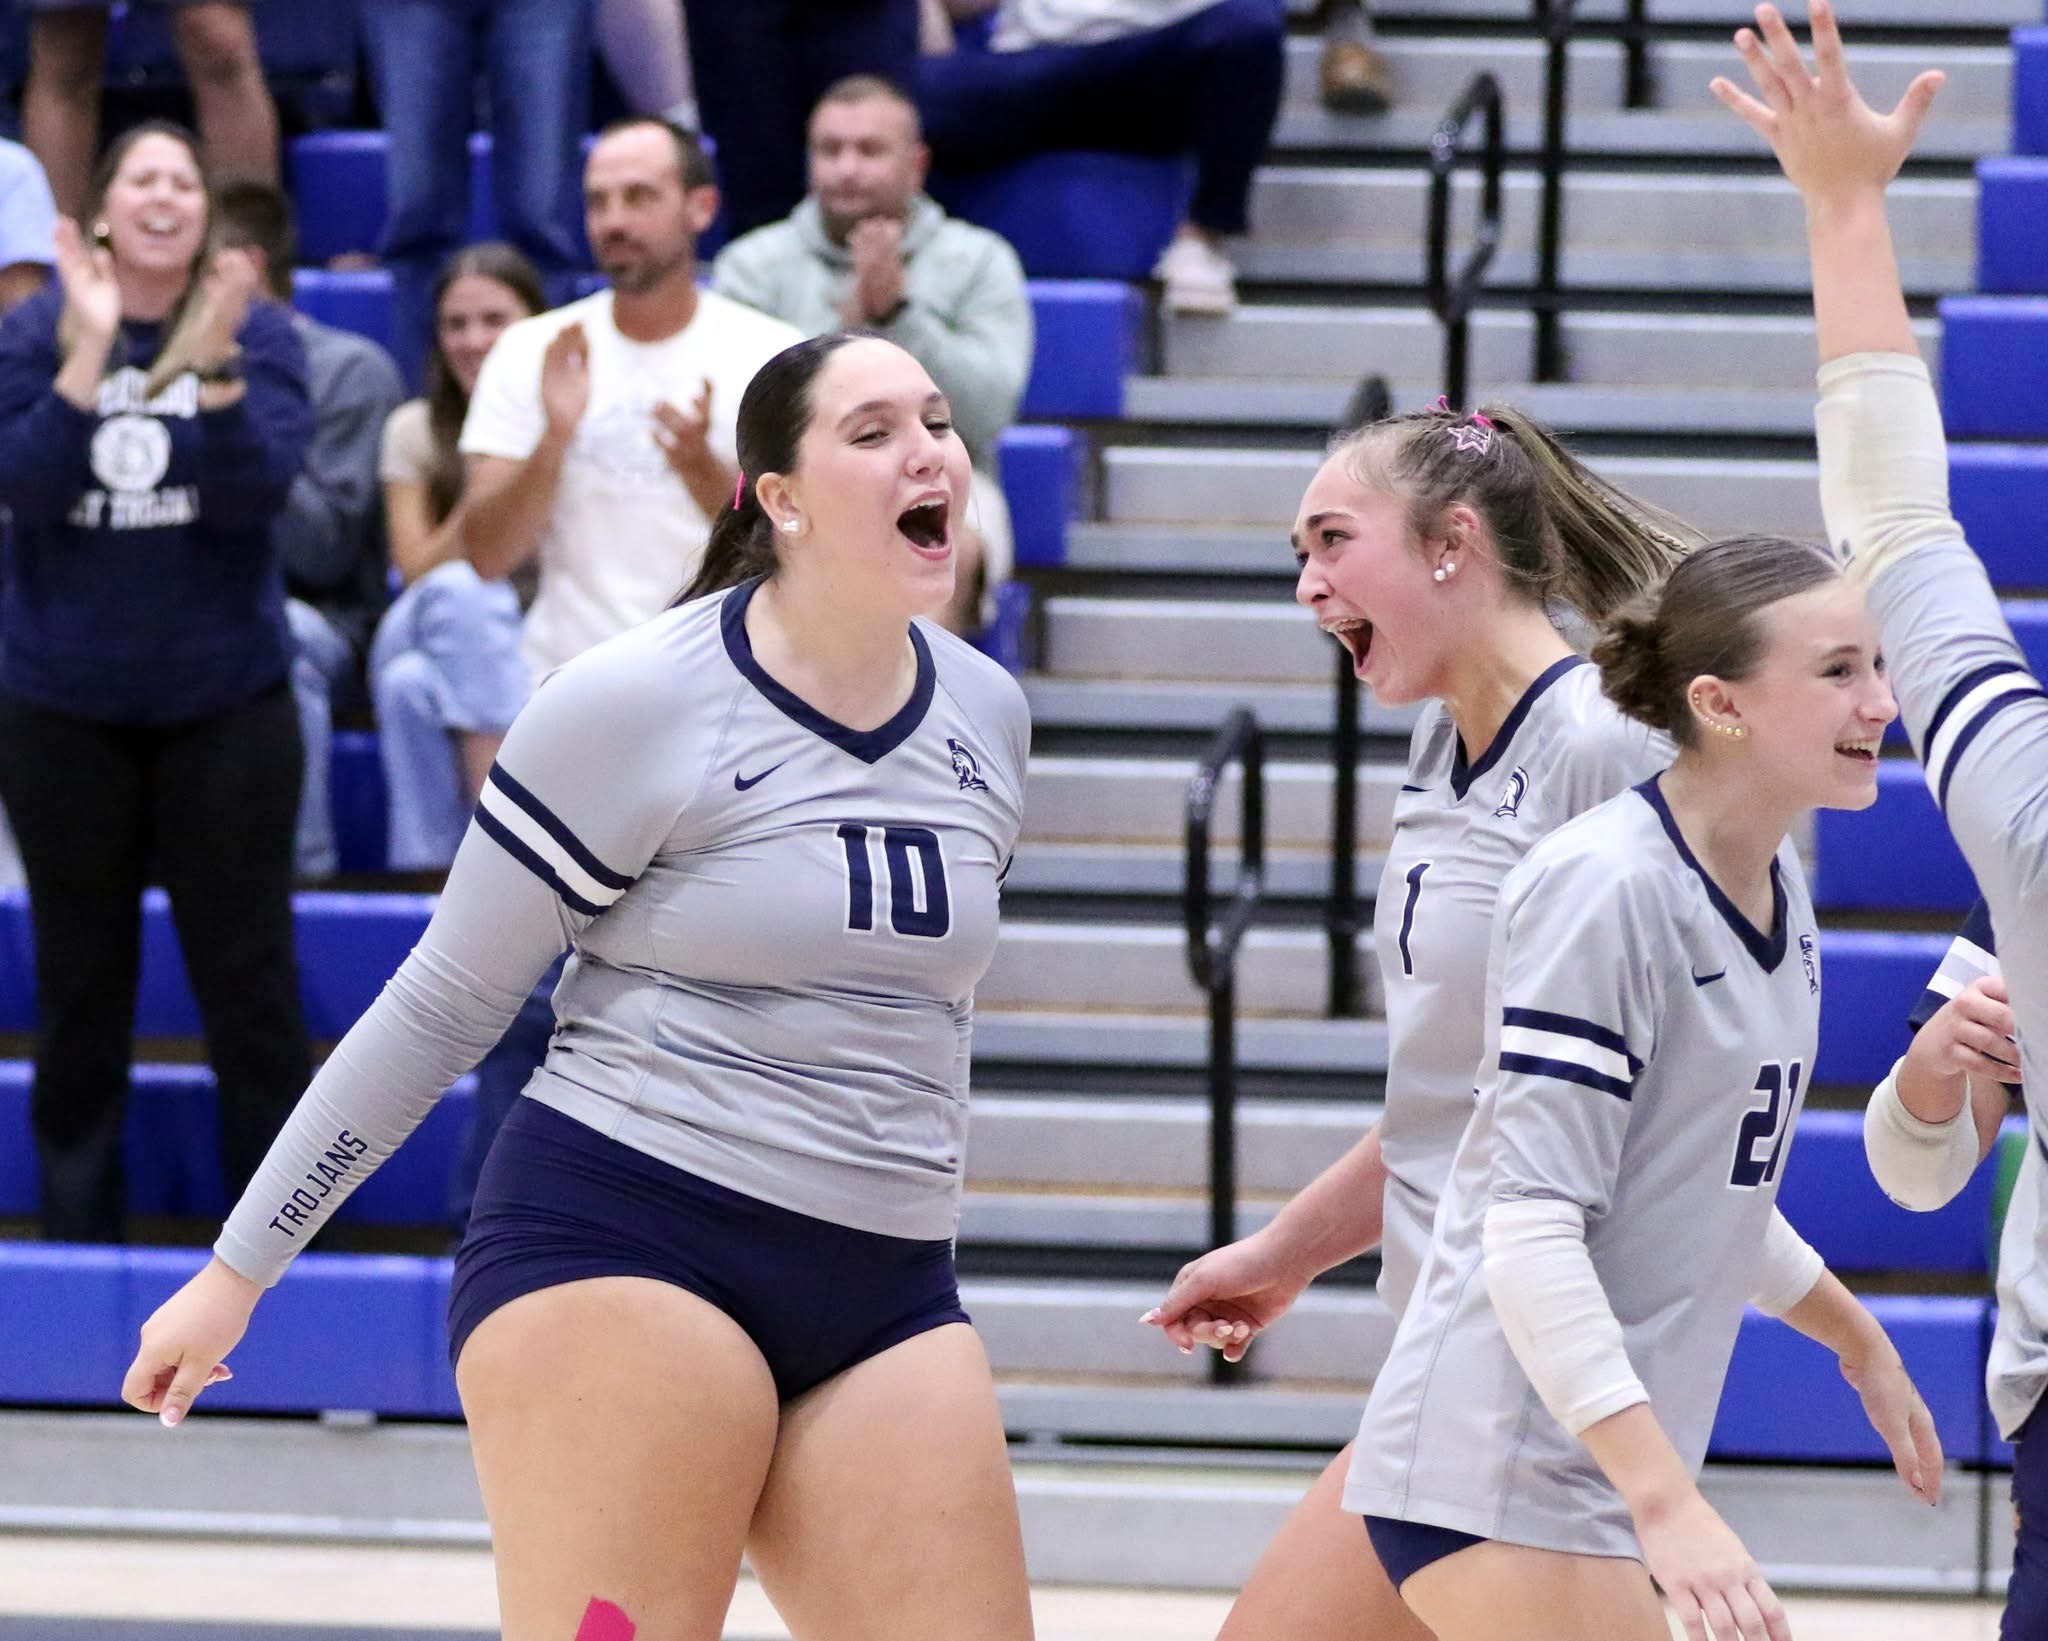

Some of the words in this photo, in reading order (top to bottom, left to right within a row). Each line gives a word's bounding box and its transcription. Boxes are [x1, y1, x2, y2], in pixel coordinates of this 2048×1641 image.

[834, 824, 953, 941] 10
[1399, 860, 1433, 978] 1
[1727, 1057, 1802, 1191] 21
[269, 1130, 368, 1237] TROJANS
